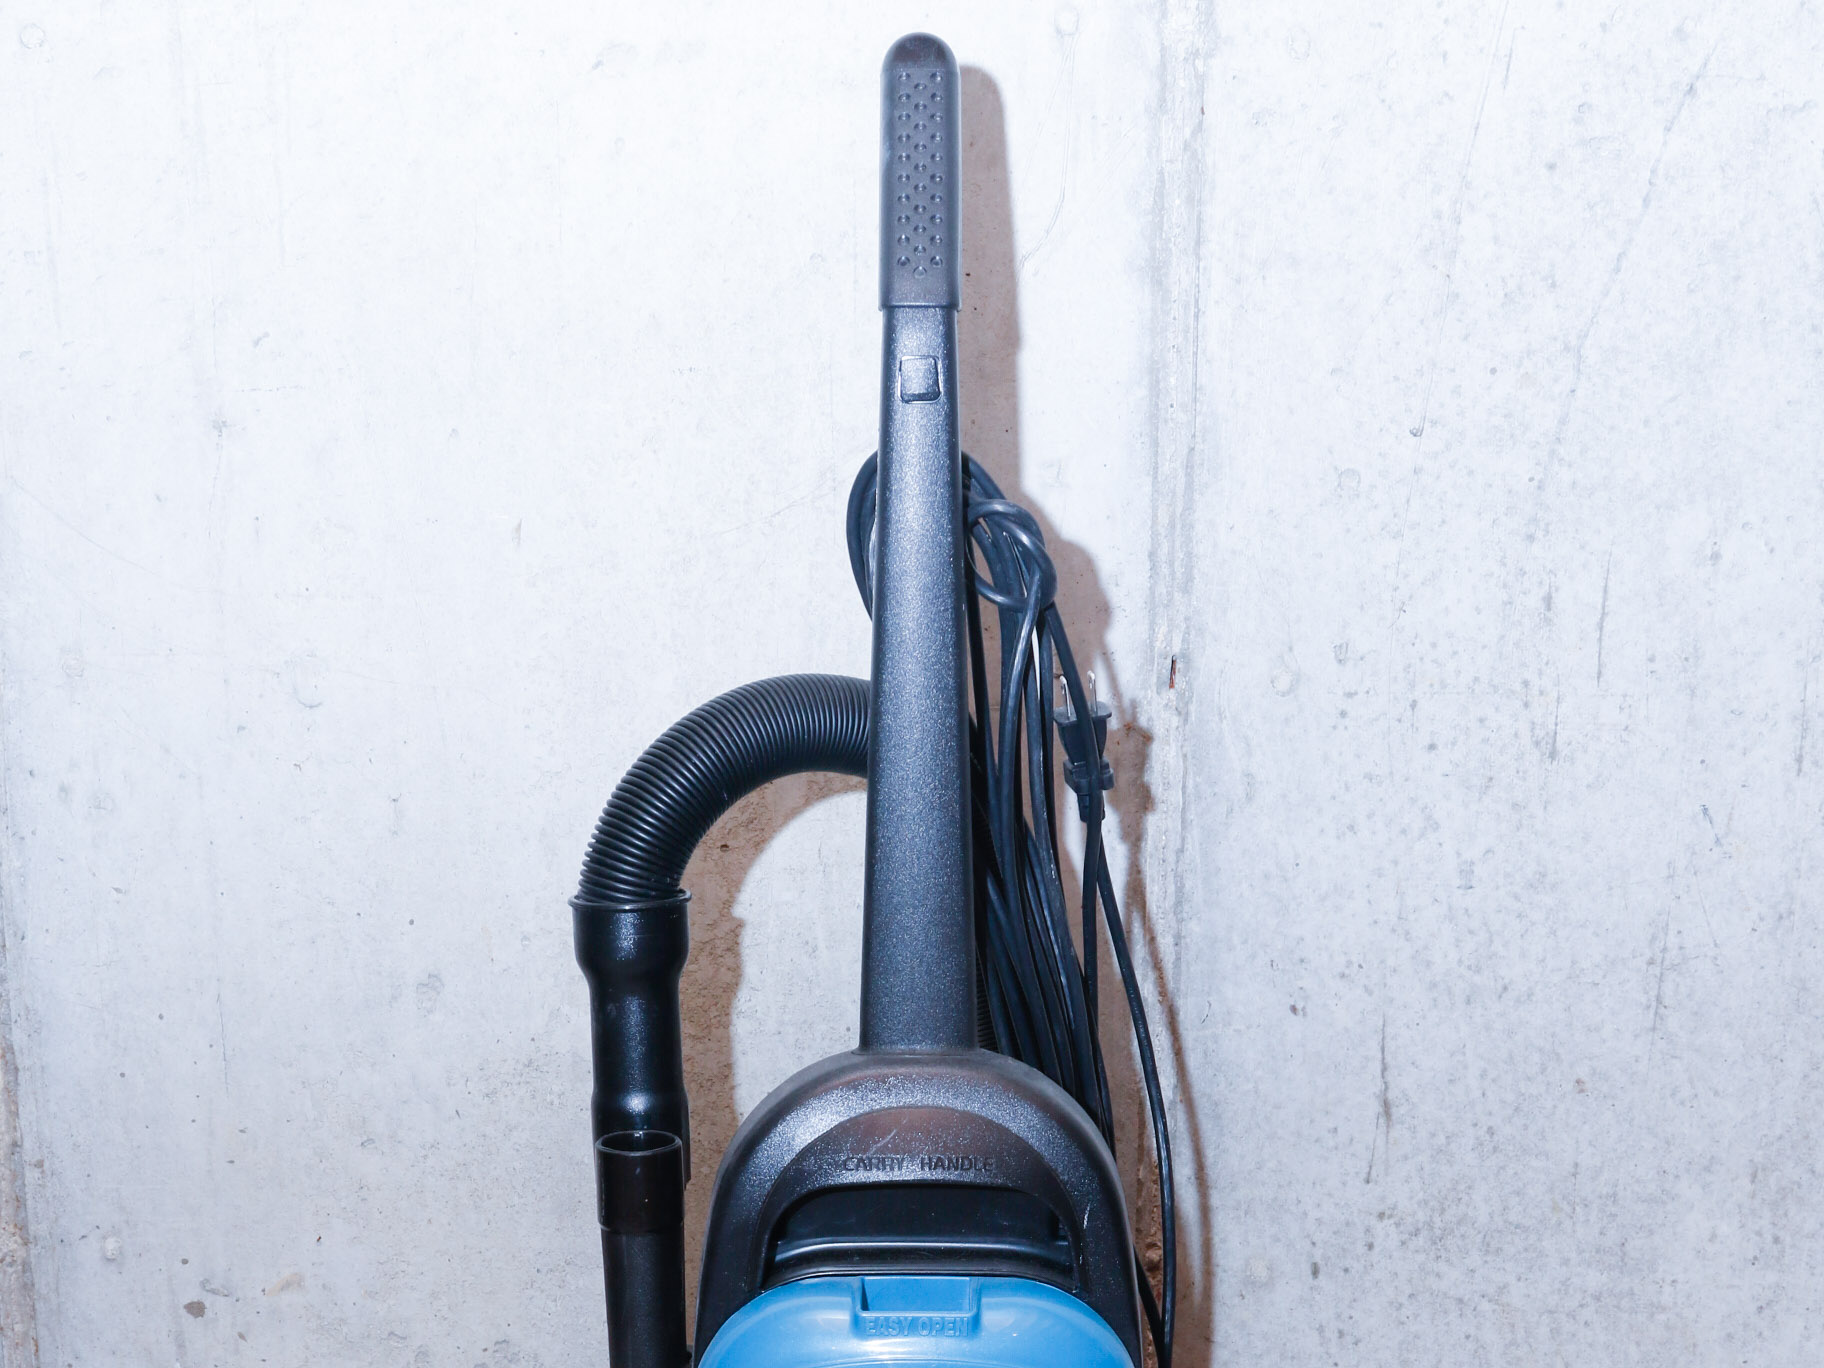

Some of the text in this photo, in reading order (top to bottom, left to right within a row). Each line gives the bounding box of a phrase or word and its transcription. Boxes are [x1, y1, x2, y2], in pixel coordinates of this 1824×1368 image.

[843, 1155, 994, 1172] CARRY HANDLE
[865, 1317, 969, 1337] EASY OPEN
